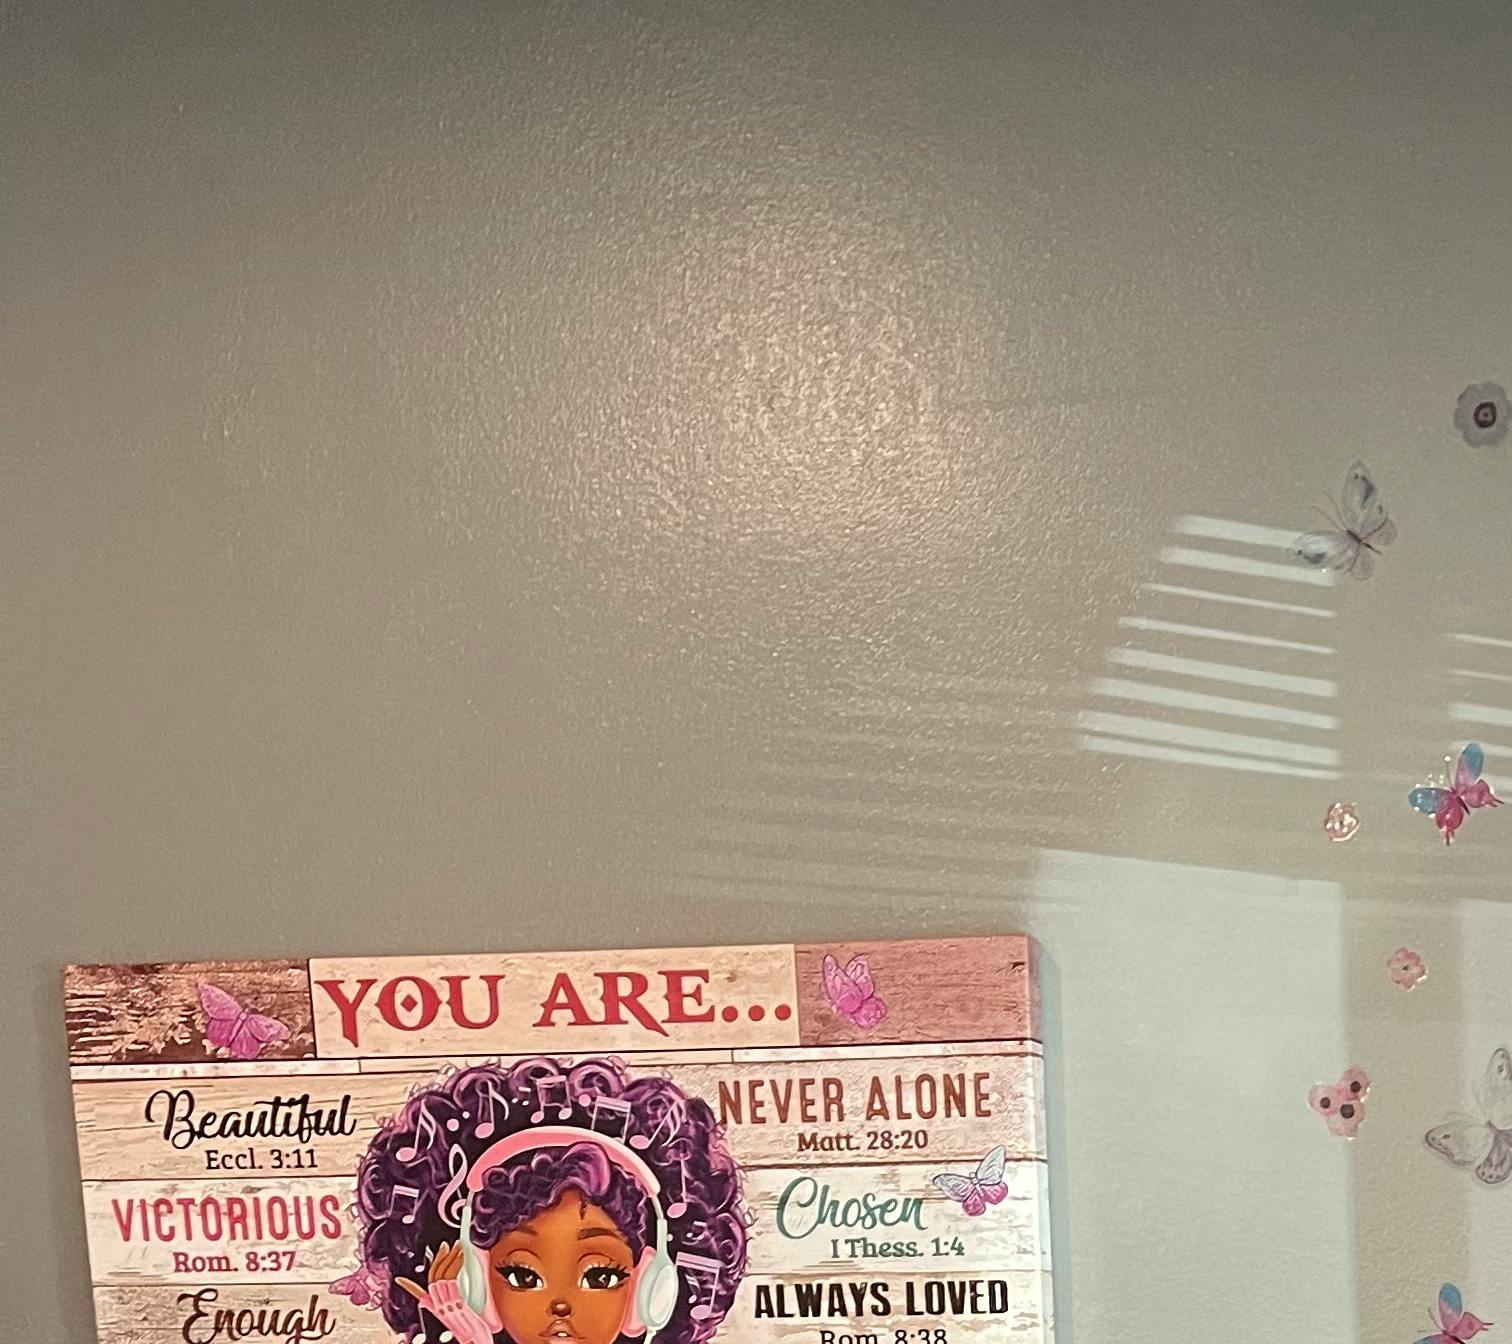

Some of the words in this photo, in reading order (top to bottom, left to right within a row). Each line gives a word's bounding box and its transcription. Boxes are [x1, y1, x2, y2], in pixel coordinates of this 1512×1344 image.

[316, 973, 506, 1042] YOU
[534, 968, 795, 1036] ARE...
[143, 1090, 358, 1148] Beautiful
[718, 1075, 846, 1128] NEVER
[866, 1072, 992, 1122] ALONE
[205, 1147, 266, 1170] Eccl.
[270, 1146, 319, 1170] 3:11
[796, 1129, 861, 1153] Matt.
[868, 1128, 929, 1152] 28:20
[113, 1195, 342, 1243] VICTORIOUS
[777, 1177, 928, 1241] Chosen
[173, 1252, 236, 1274] Rom.
[240, 1251, 296, 1273] 8:37
[843, 1238, 924, 1259] Thess.
[932, 1237, 964, 1257] 1:4
[755, 1281, 895, 1319] ALWAYS
[906, 1278, 1009, 1317] LOVED
